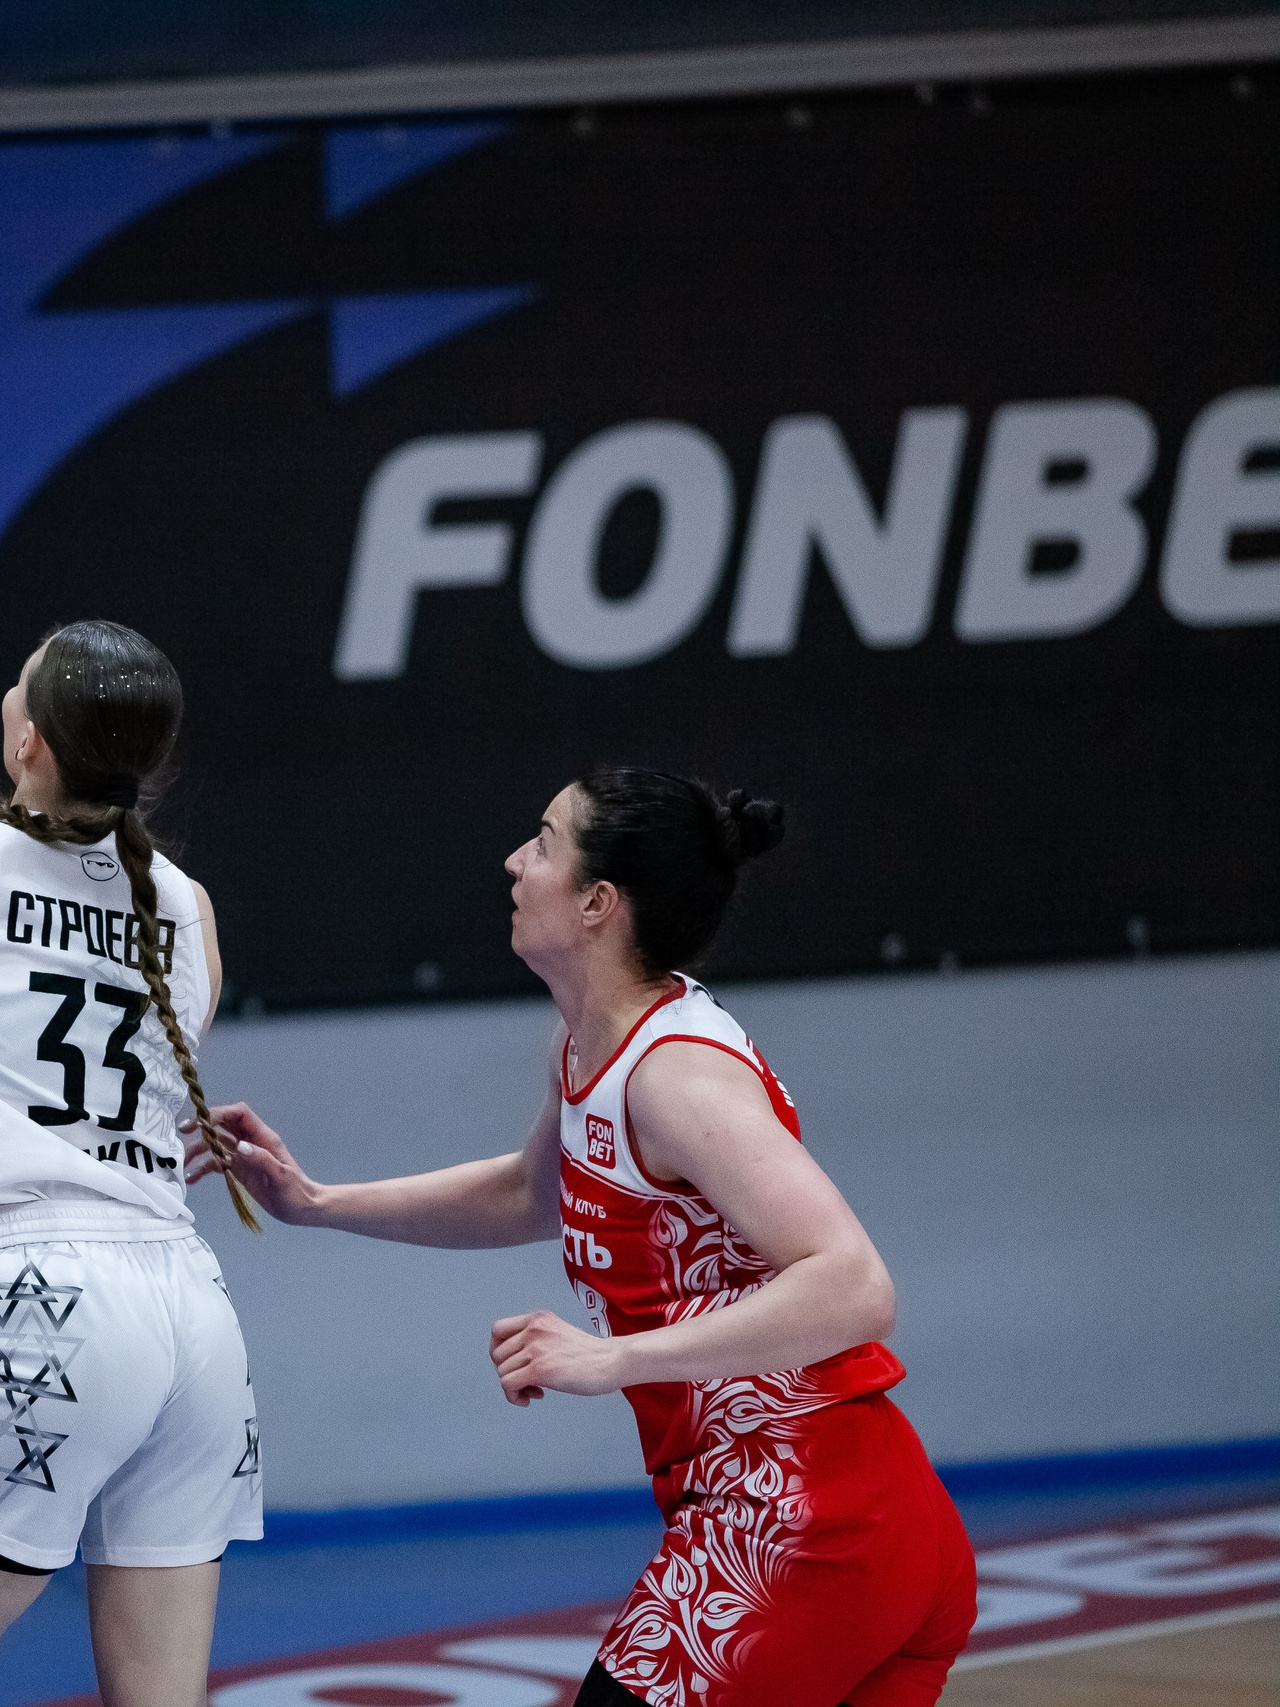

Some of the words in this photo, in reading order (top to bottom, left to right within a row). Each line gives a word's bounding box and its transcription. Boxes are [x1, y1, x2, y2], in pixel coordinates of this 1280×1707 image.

[332, 386, 1280, 682] FONBE
[28, 971, 149, 1132] 33
[588, 1120, 612, 1143] FON
[589, 1138, 613, 1162] BET
[575, 1198, 607, 1219] КЛУБ
[561, 1223, 612, 1269] СТЬ
